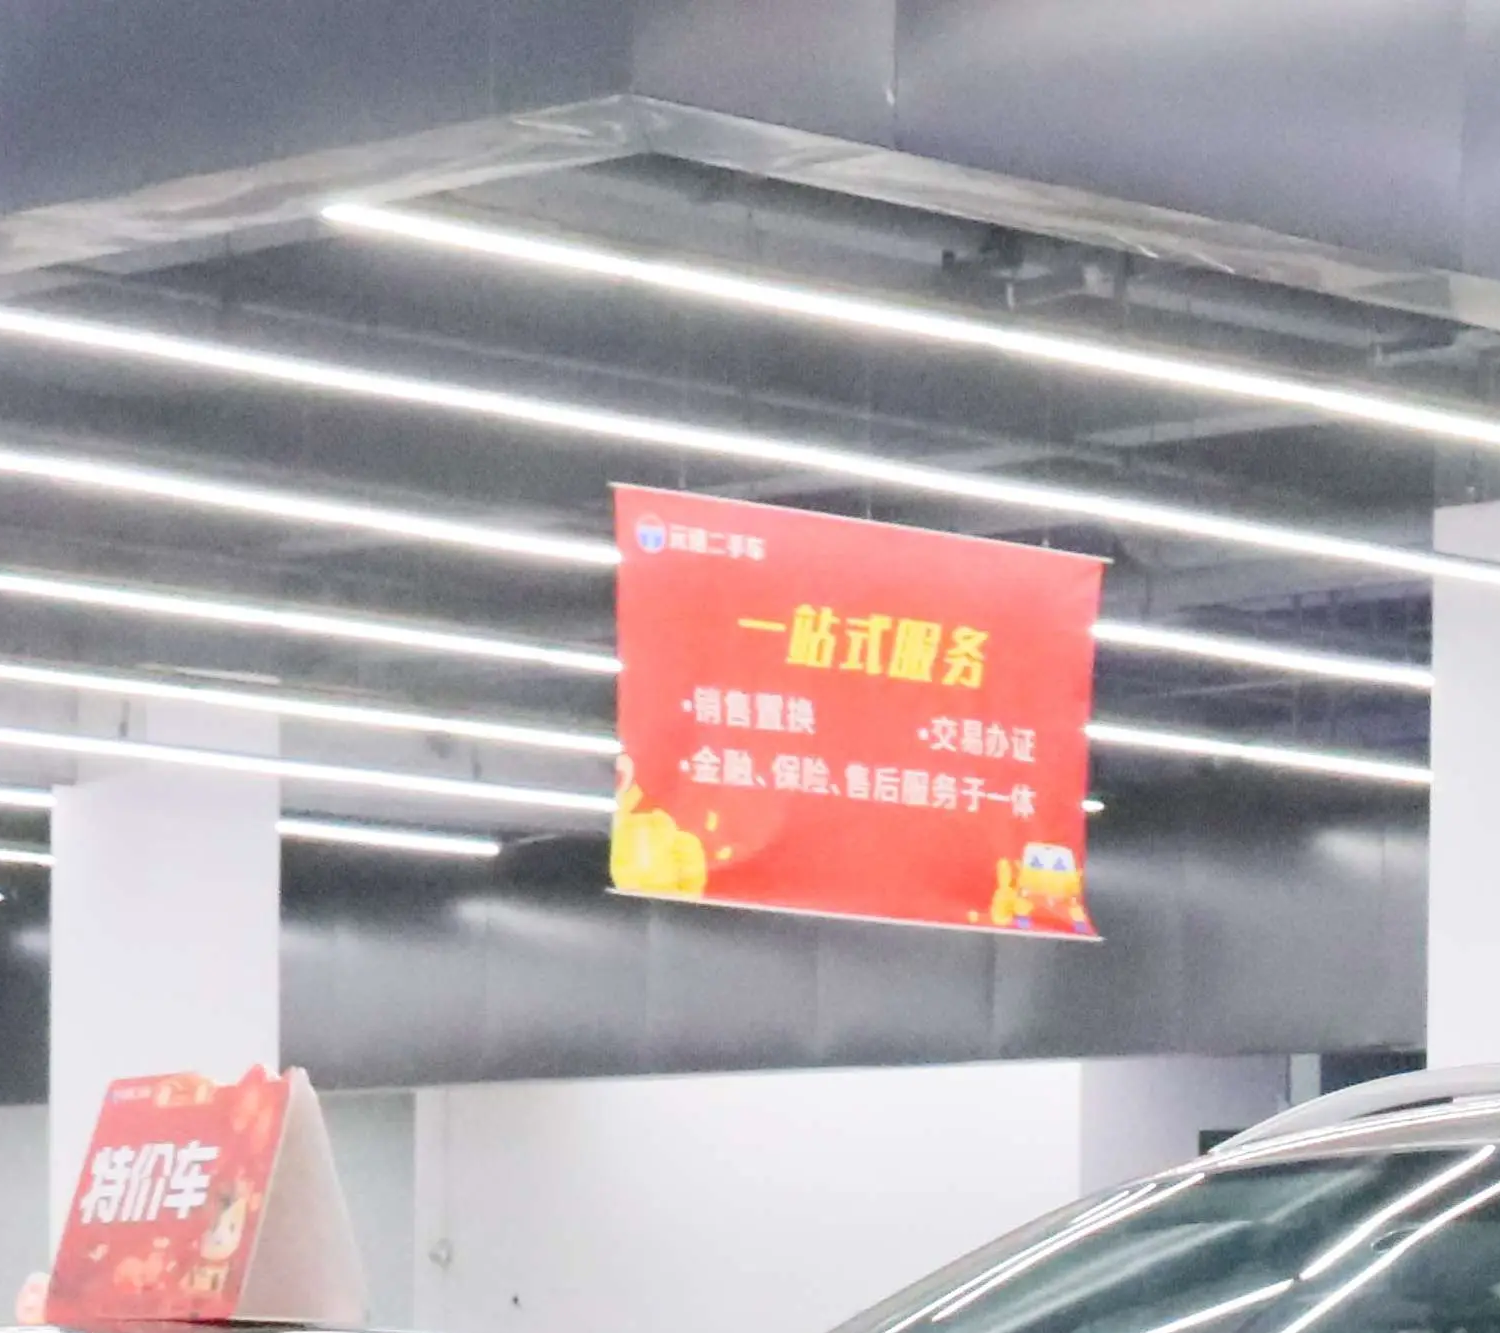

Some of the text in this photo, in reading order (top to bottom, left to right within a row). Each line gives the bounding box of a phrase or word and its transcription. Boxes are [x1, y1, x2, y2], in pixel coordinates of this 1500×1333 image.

[737, 603, 989, 689] 一站式服务
[692, 686, 817, 735] 销售置换
[929, 717, 1037, 764] 交易办证
[80, 1140, 221, 1225] 特价车
